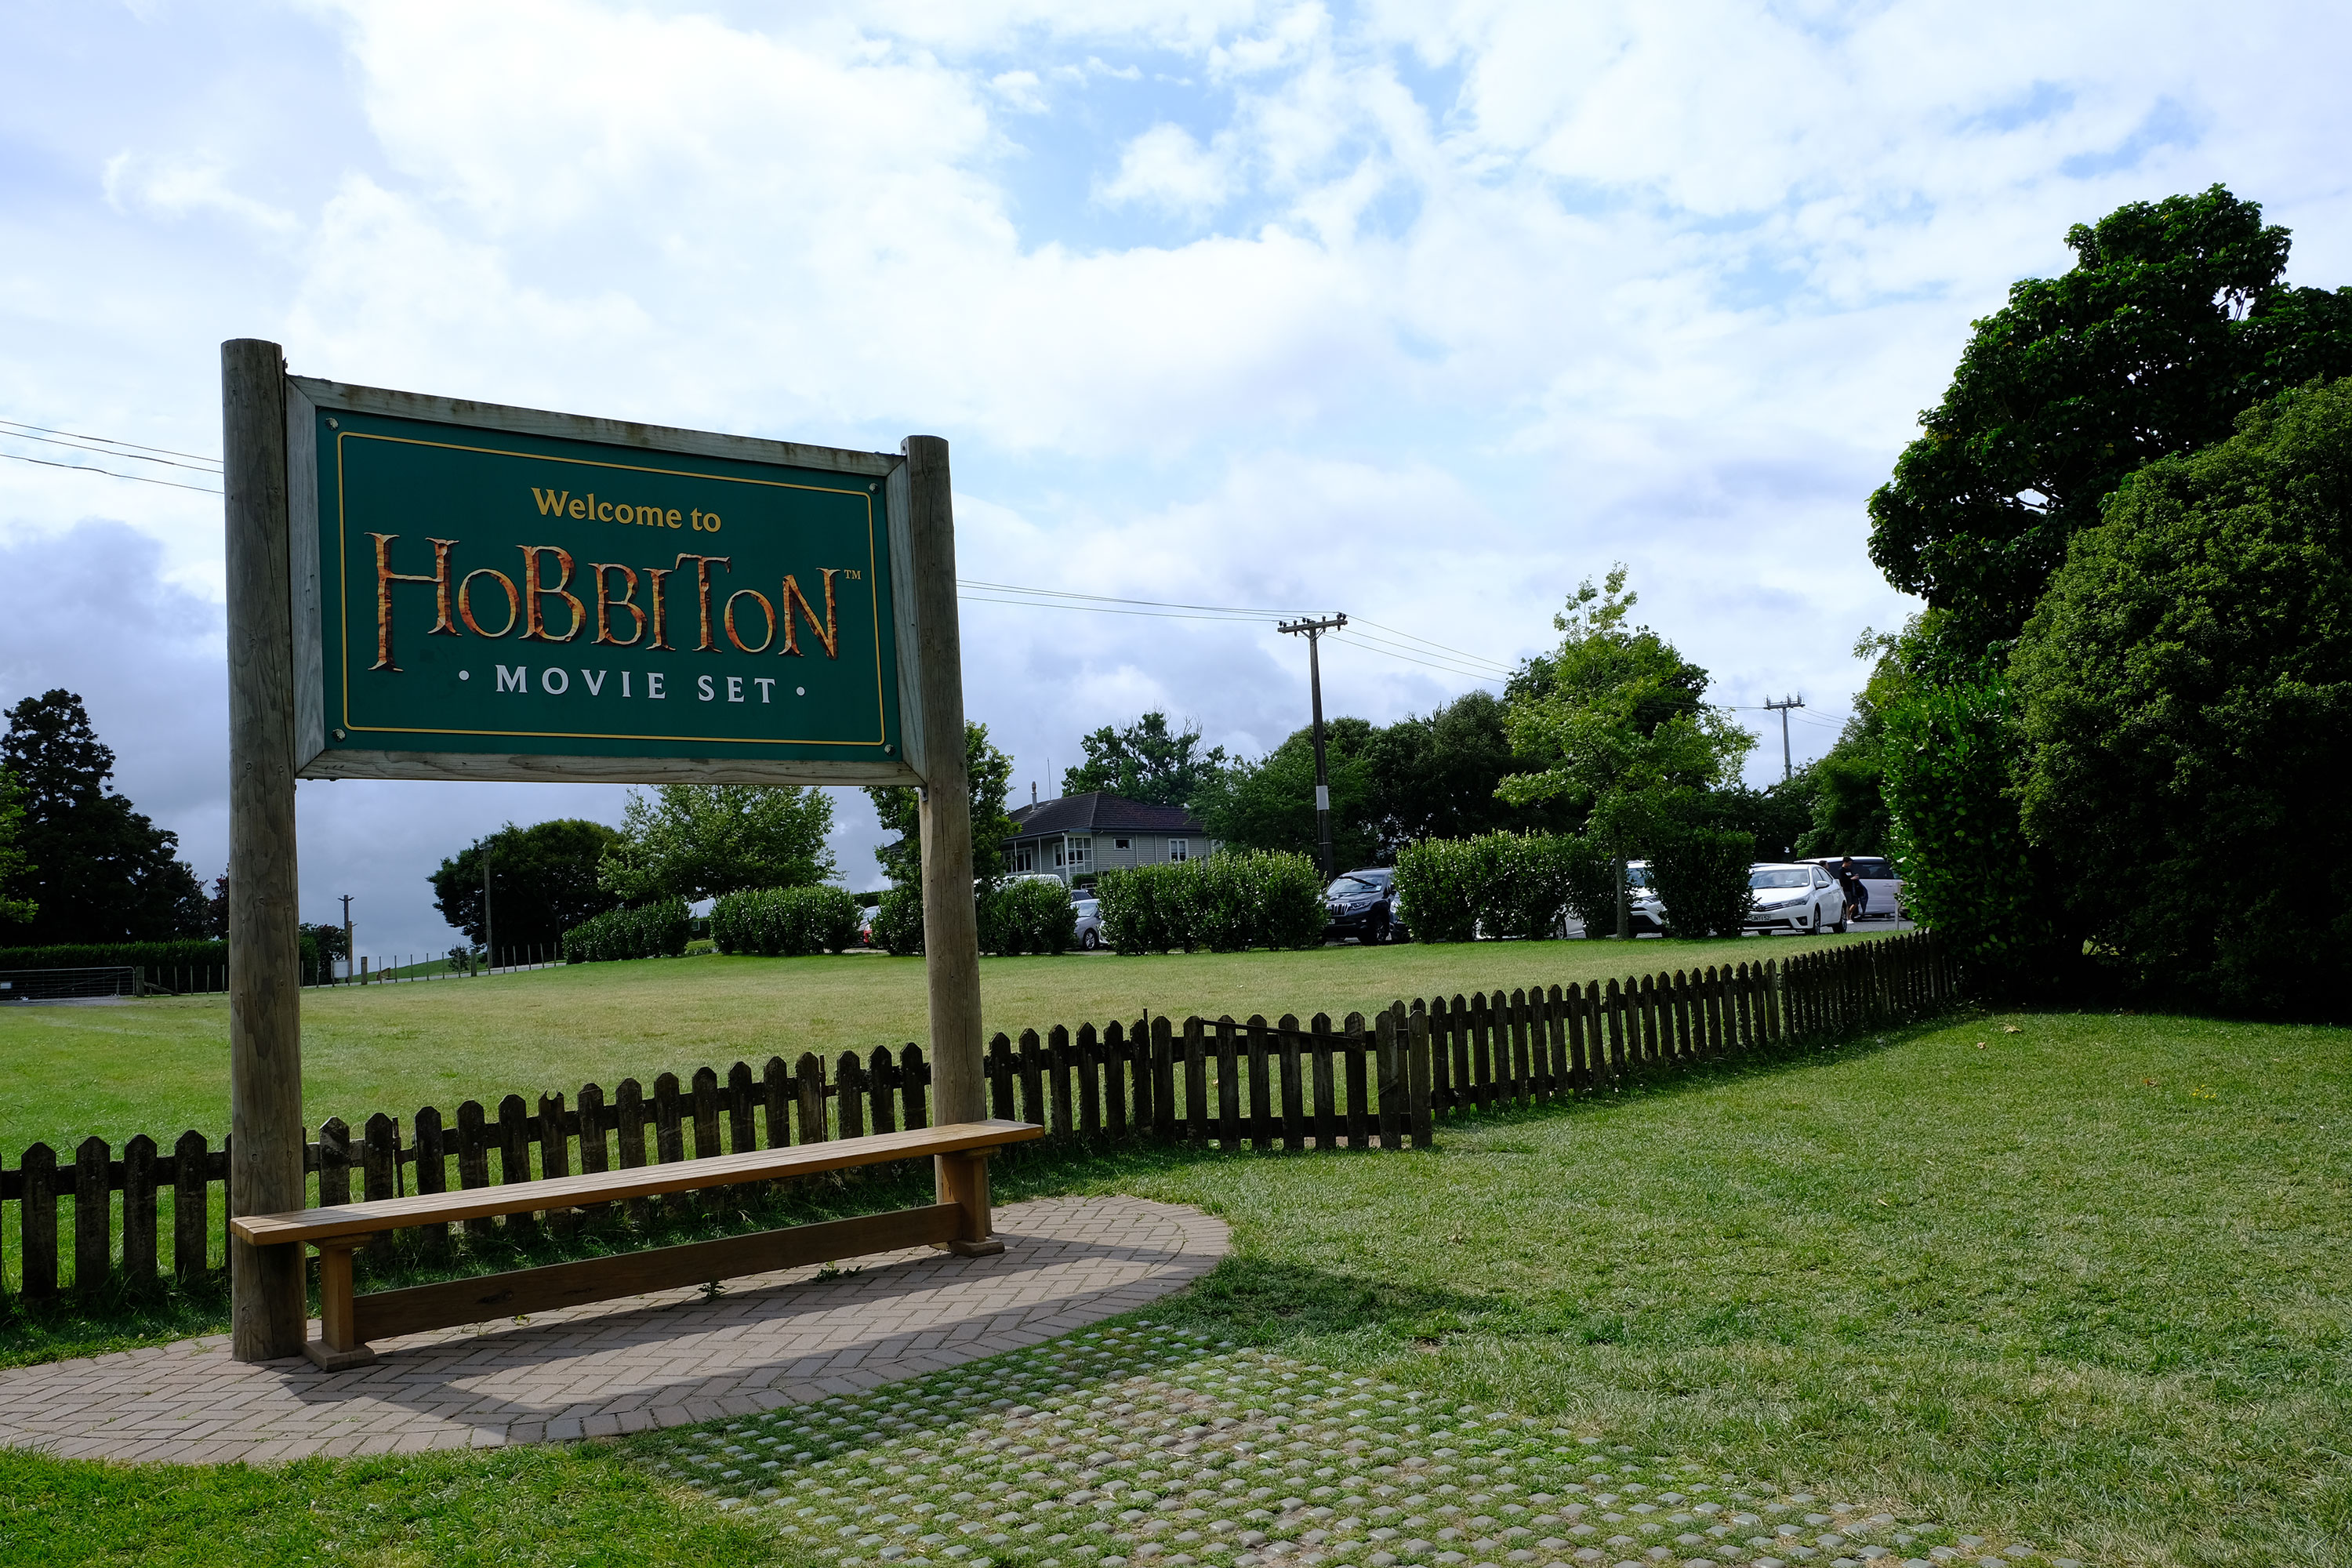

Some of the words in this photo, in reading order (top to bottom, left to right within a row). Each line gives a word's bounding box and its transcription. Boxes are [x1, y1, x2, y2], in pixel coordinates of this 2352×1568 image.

[532, 488, 681, 529] Welcome
[691, 507, 722, 532] to
[495, 665, 666, 699] MOVIE
[698, 675, 775, 703] SET
